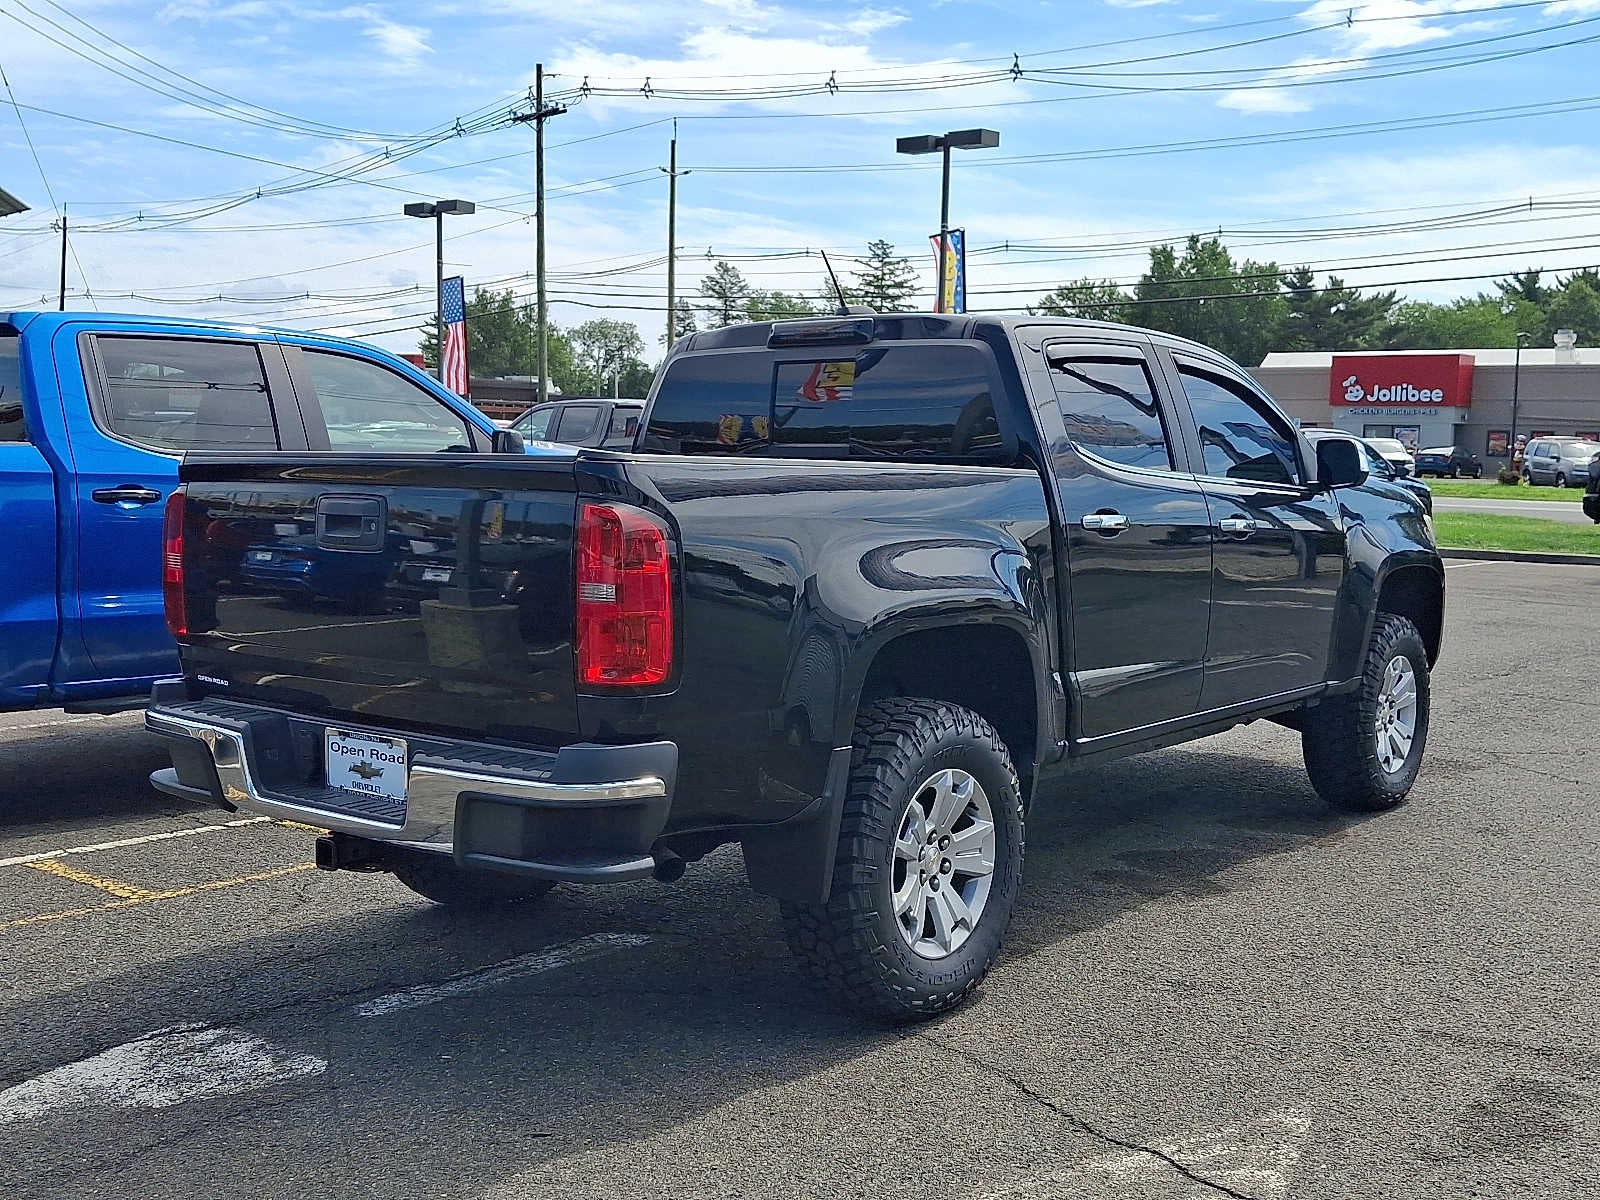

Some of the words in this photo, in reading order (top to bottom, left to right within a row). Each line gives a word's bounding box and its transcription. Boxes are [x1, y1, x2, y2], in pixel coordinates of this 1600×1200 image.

[1366, 384, 1443, 402] Jollibee
[198, 675, 213, 683] OPEN
[212, 678, 229, 686] ROAD
[331, 741, 365, 757] Open
[370, 748, 404, 765] Road
[352, 780, 382, 793] CHEVROLET
